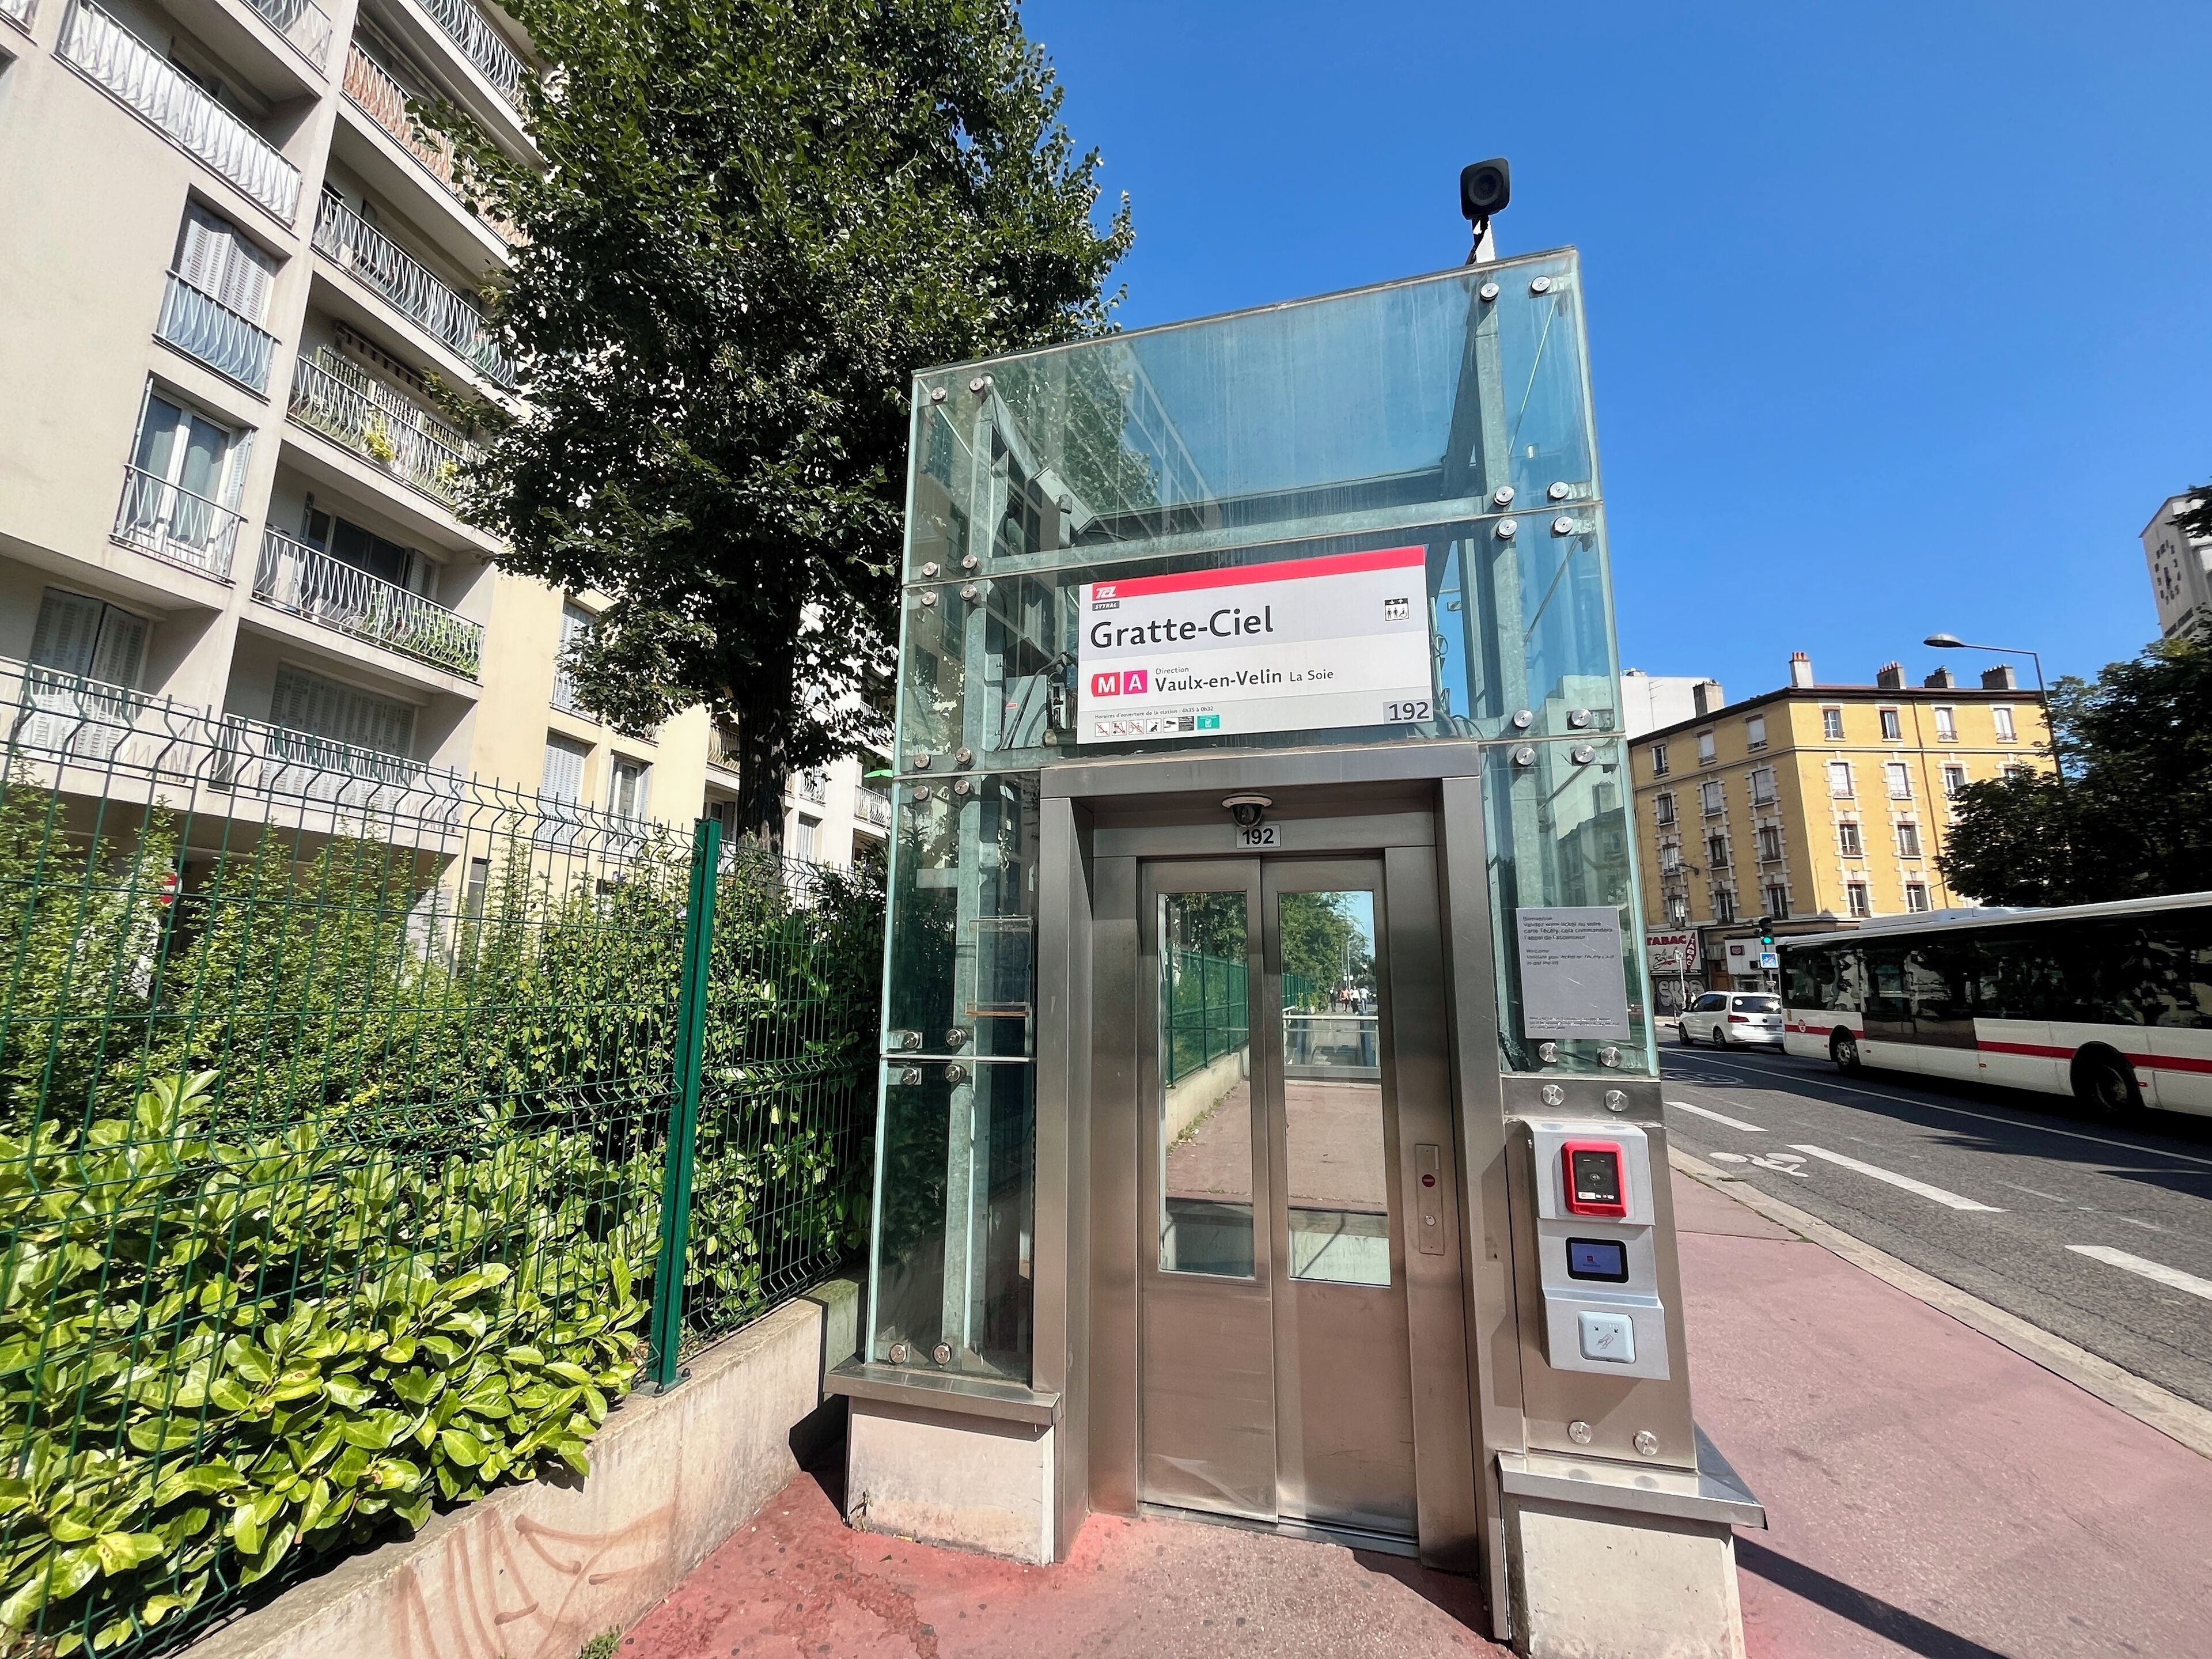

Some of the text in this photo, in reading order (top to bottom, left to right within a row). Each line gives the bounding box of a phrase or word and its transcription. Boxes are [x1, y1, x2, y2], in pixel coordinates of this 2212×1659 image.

[1090, 605, 1273, 648] Gratte-Ciel
[1156, 666, 1190, 675] Direction
[1097, 673, 1143, 694] M A
[1156, 669, 1334, 692] Vaulx-en-Velin La Soie
[1388, 702, 1429, 721] 192
[1243, 828, 1274, 845] 192
[1647, 935, 1687, 945] TABAC
